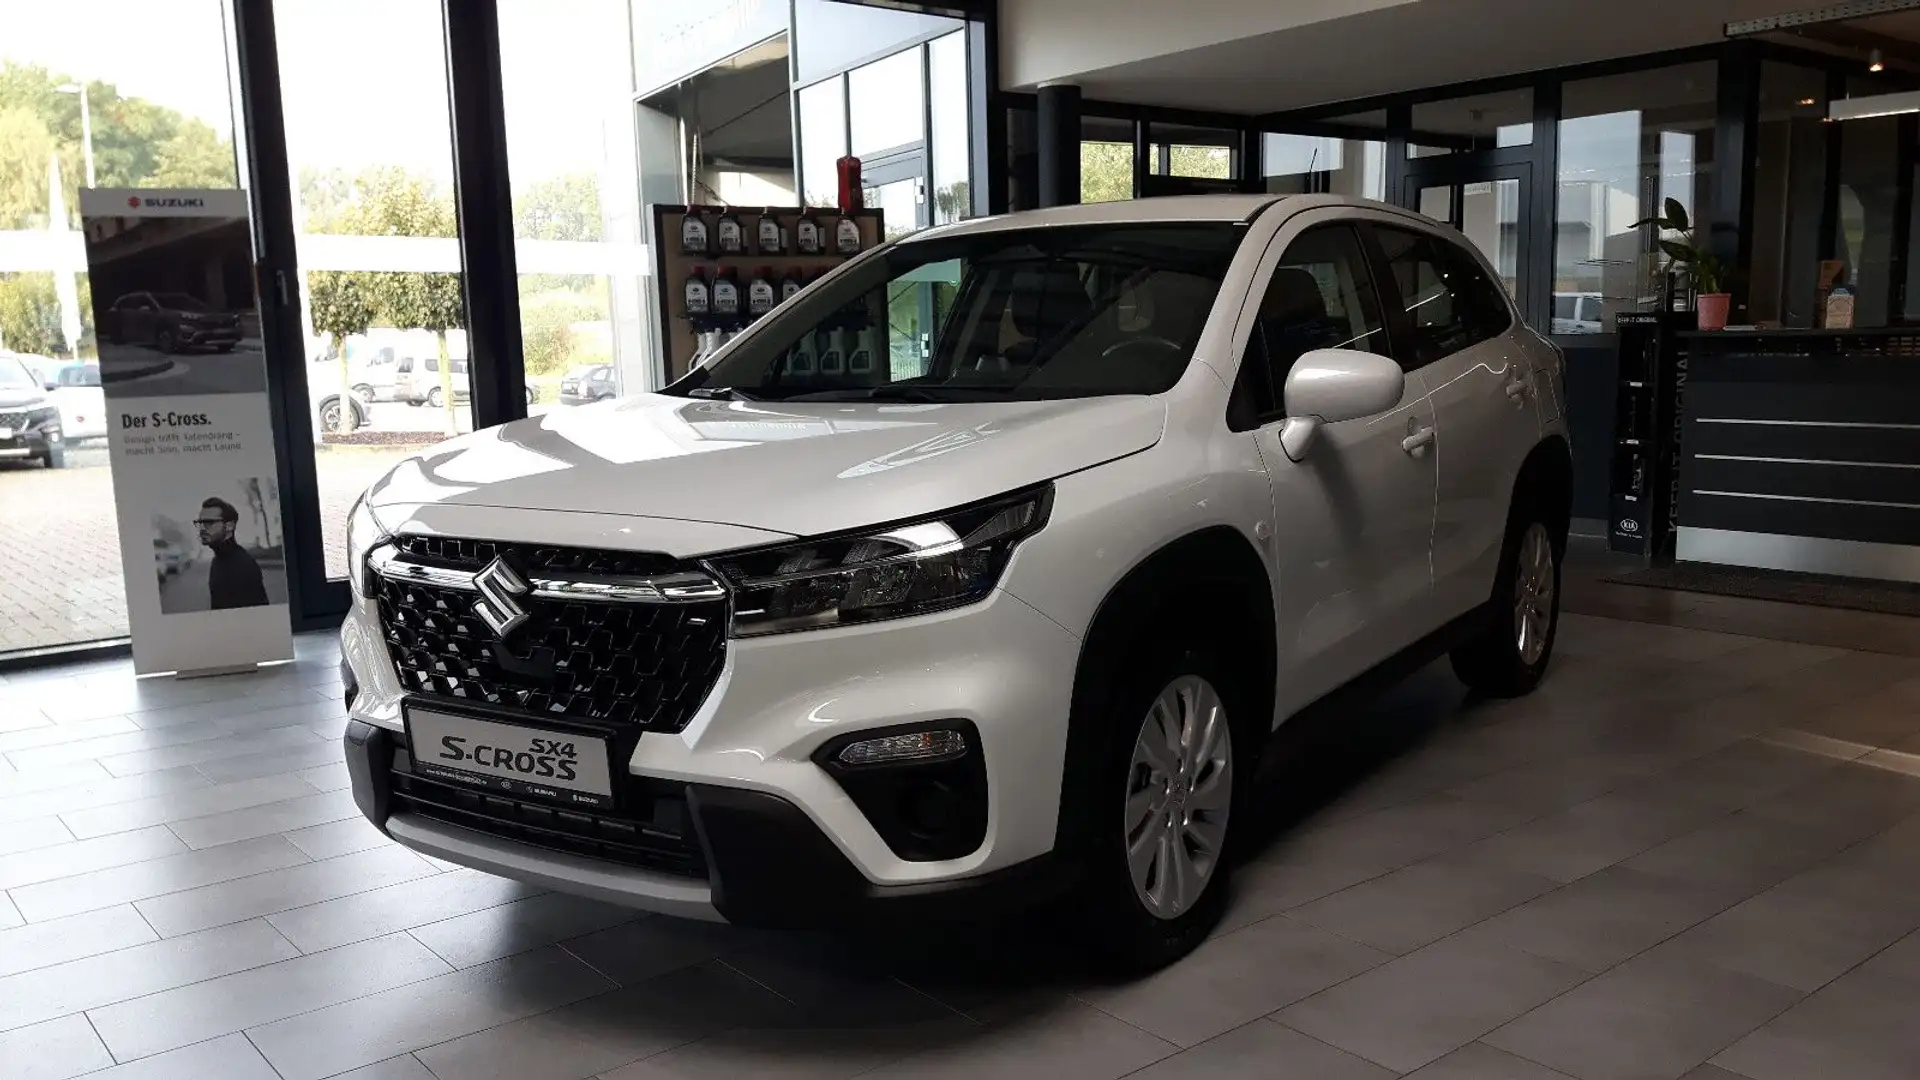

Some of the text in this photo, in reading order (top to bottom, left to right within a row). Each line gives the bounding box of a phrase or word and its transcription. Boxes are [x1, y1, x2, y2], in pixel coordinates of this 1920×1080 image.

[145, 198, 203, 207] SUZUKI
[122, 412, 212, 429] Der S-Cross.
[529, 738, 577, 758] SX4
